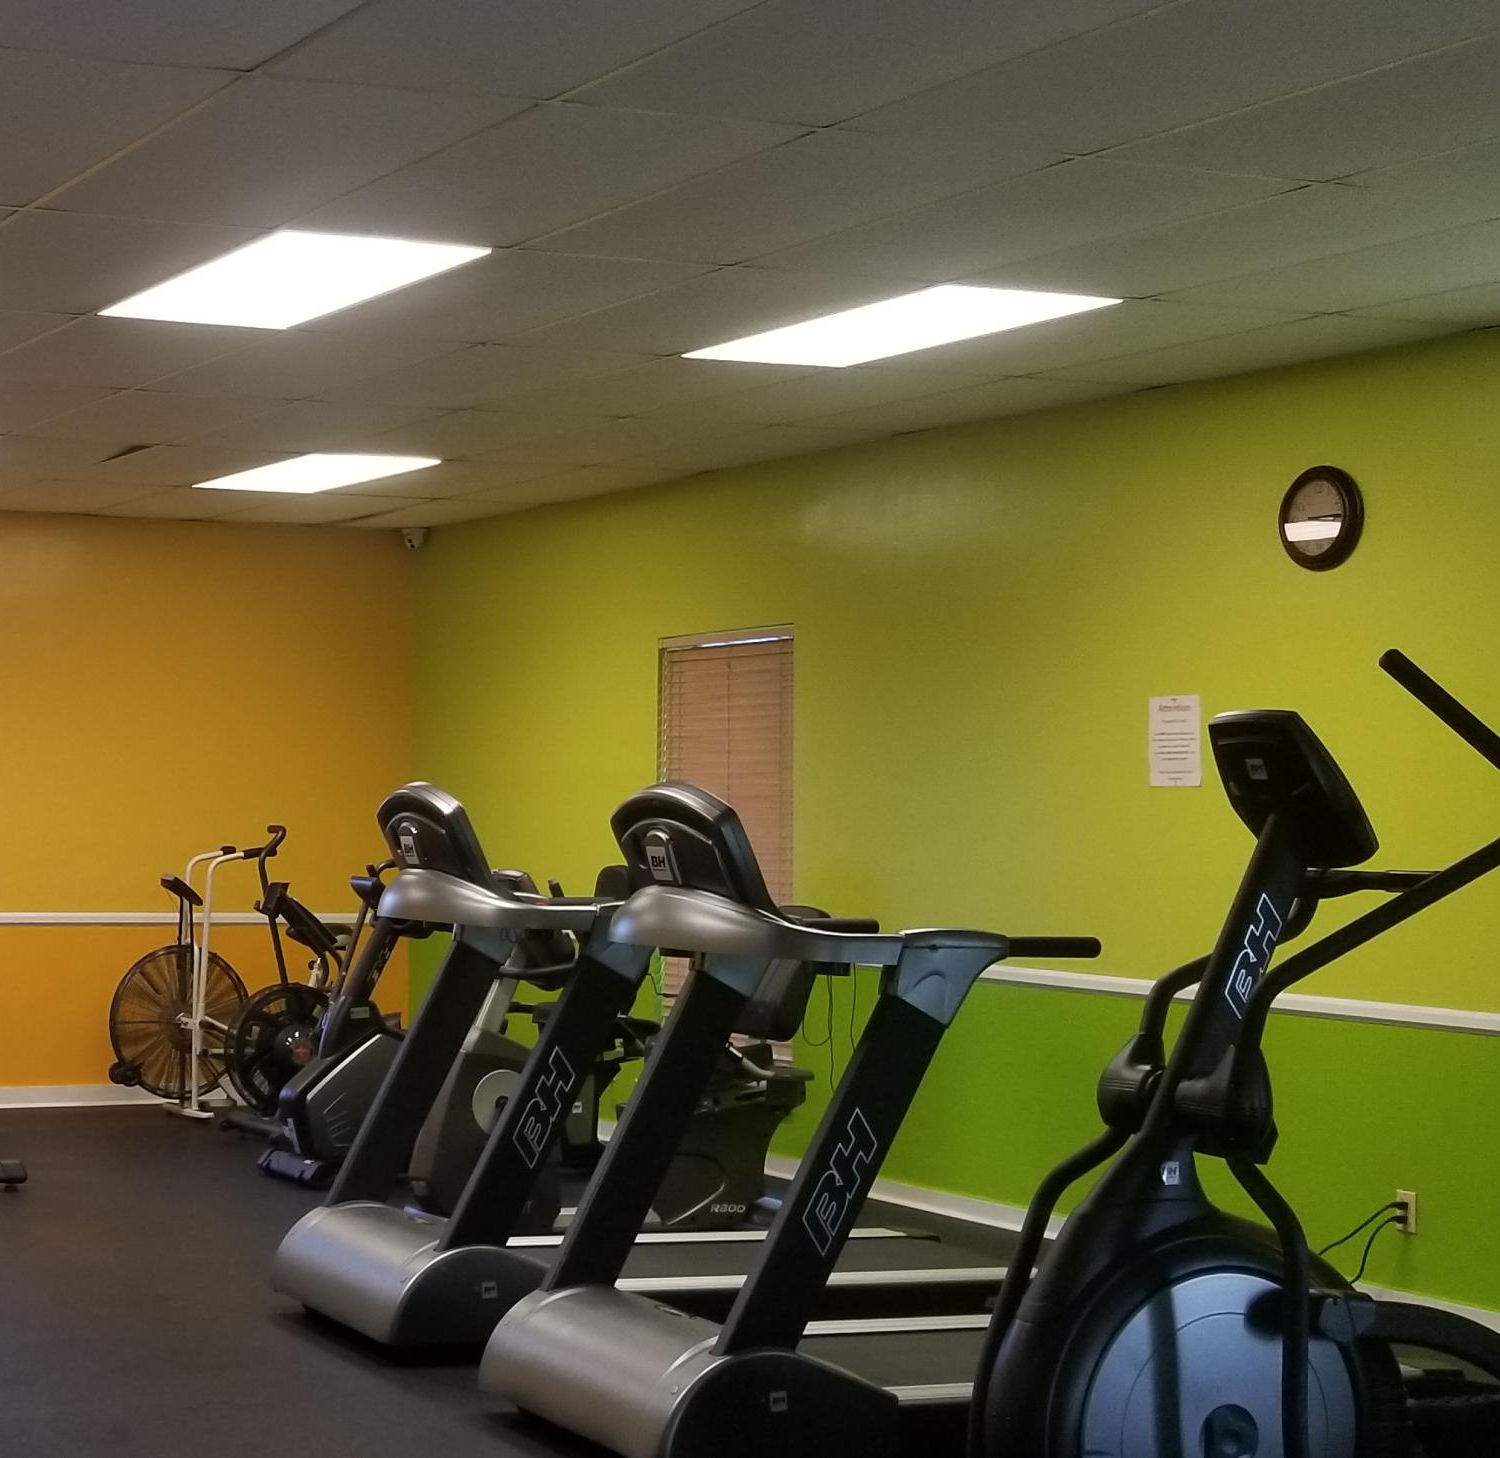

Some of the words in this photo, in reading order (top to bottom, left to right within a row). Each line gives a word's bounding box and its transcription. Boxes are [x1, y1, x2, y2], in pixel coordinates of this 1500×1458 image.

[650, 855, 666, 868] BH
[1224, 893, 1283, 1019] BH
[512, 1045, 576, 1169] BH
[802, 1107, 878, 1257] BH
